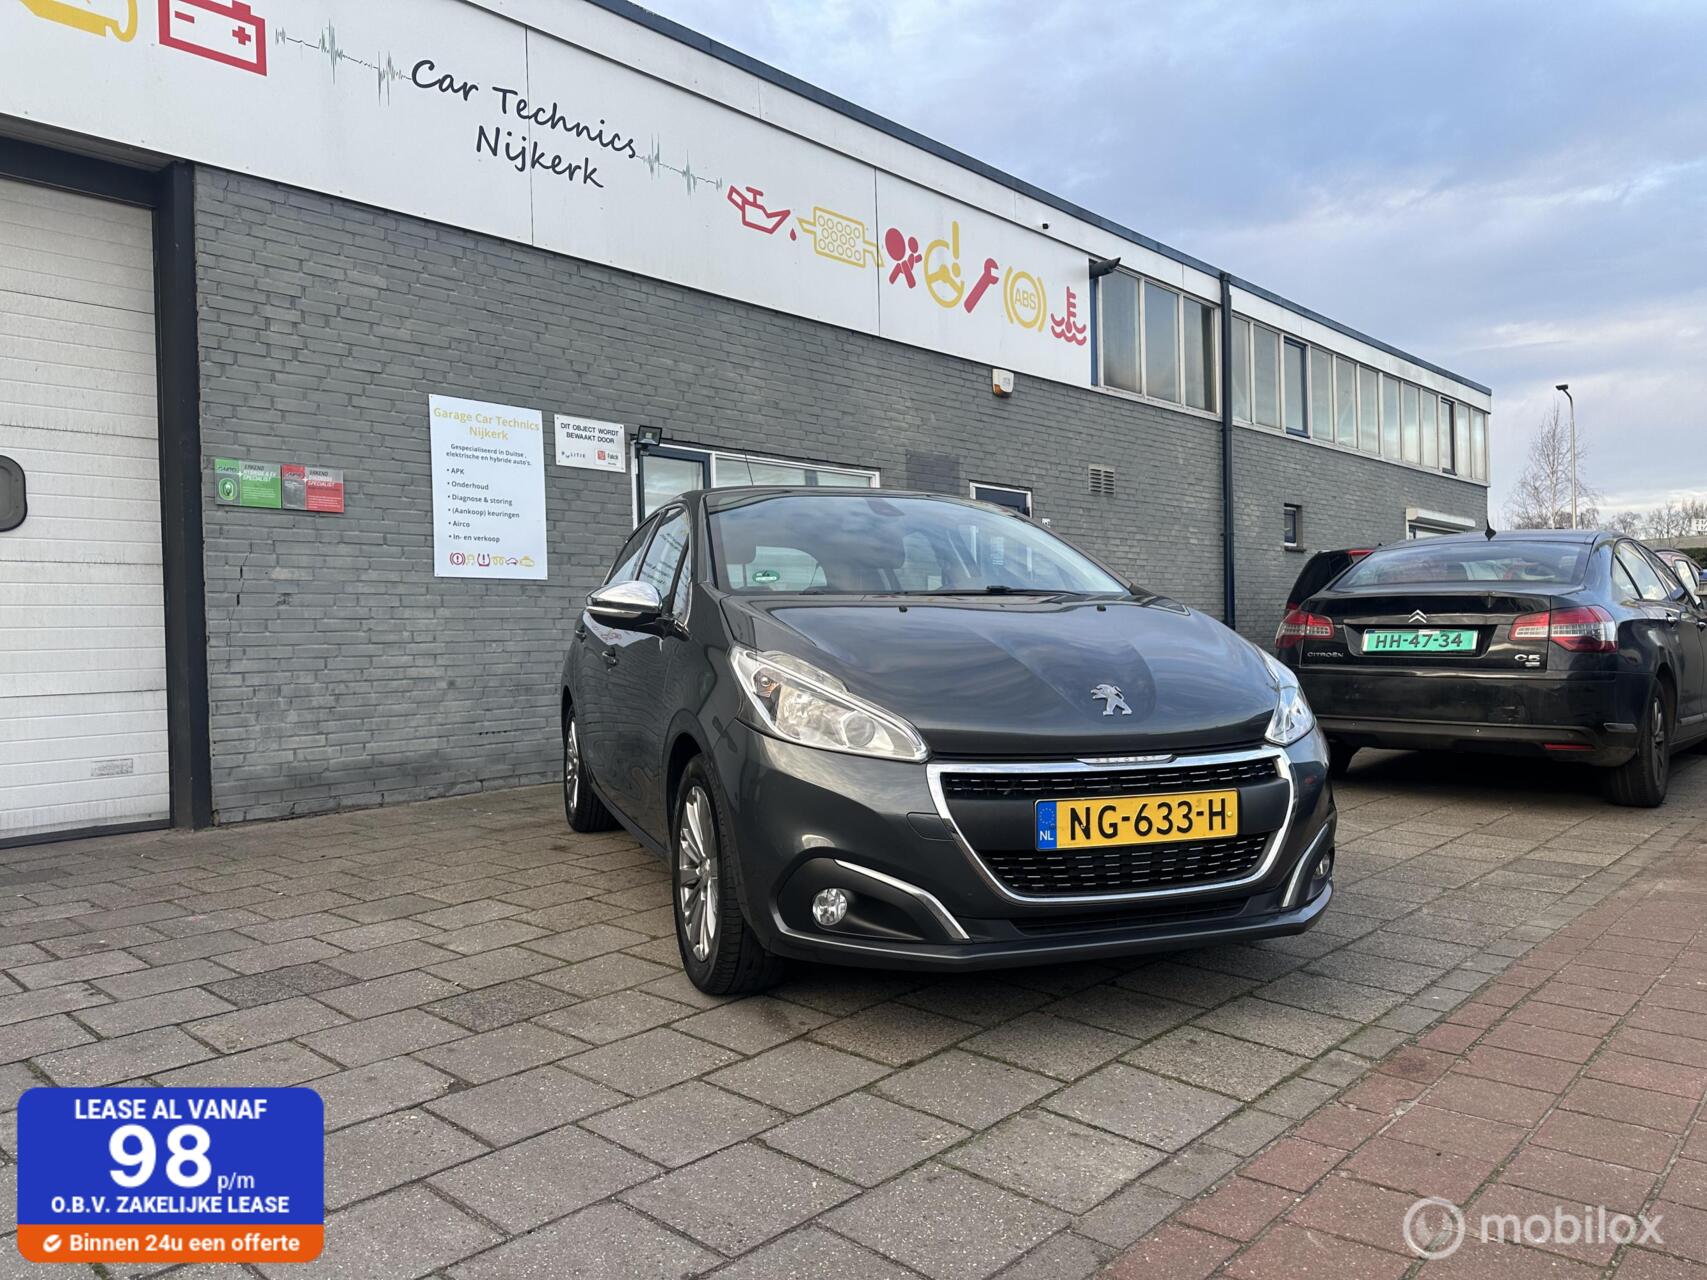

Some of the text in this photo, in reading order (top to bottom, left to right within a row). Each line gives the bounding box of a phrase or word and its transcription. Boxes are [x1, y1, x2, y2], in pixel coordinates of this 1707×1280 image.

[411, 59, 636, 159] Car Technics
[476, 125, 604, 188] Nijkerk
[1015, 288, 1036, 310] ABS
[434, 408, 540, 431] Garage Car Technics
[469, 426, 508, 440] Nijkerk
[560, 422, 619, 436] DIT OBJECT WORDT
[566, 432, 614, 444] BEWAAKT DOOR
[450, 443, 498, 455] Gespecialiseerd
[446, 451, 480, 460] elektrische
[489, 456, 512, 464] hybride
[451, 467, 465, 475] APK
[451, 480, 489, 490] Onderhoud
[451, 494, 482, 503] Diagnose
[489, 498, 513, 507] storing
[452, 507, 520, 519] (Aankoop) keuringen
[452, 520, 471, 528] Airco
[473, 535, 501, 543] verkoop
[1375, 633, 1463, 649] HH-47-34
[1514, 653, 1541, 662] C5
[1069, 797, 1227, 841] NG-633-H
[1039, 830, 1054, 841] NL
